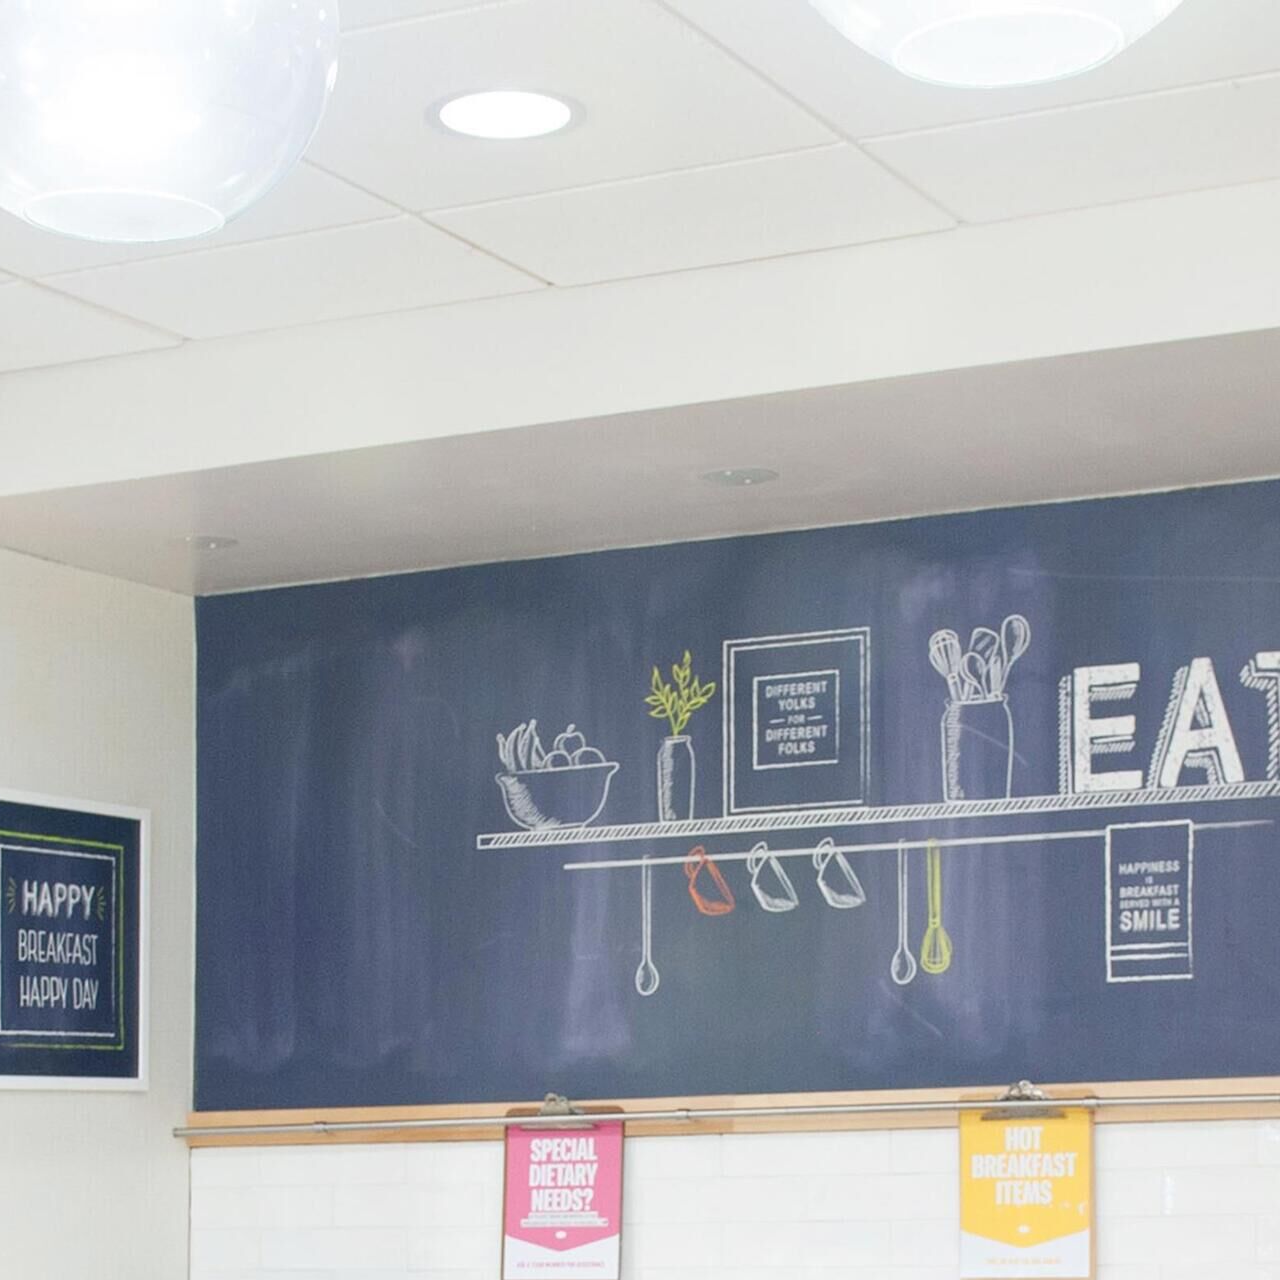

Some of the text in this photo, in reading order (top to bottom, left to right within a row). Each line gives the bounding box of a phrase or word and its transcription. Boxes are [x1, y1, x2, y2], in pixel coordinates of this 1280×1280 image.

[766, 681, 828, 698] DIFFERENT
[778, 697, 815, 711] YOLKS
[787, 714, 805, 725] FOR
[766, 725, 828, 742] DIFFERENT
[778, 741, 816, 755] FOLKS
[1118, 860, 1180, 875] HAPPINESS
[22, 880, 95, 920] HAPPY
[1119, 884, 1179, 898] BREAKFAST
[1174, 897, 1180, 906] A
[1120, 908, 1180, 932] SMILE
[18, 929, 98, 966] BREAKFAST
[20, 975, 99, 1011] HAPPY DAY
[530, 1137, 598, 1162] SPECIAL
[1004, 1125, 1043, 1151] HOT
[529, 1162, 598, 1187] DIETARY
[971, 1152, 1077, 1179] BREAKFAST
[531, 1188, 593, 1212] NEEDS?
[995, 1181, 1053, 1206] ITEMS
